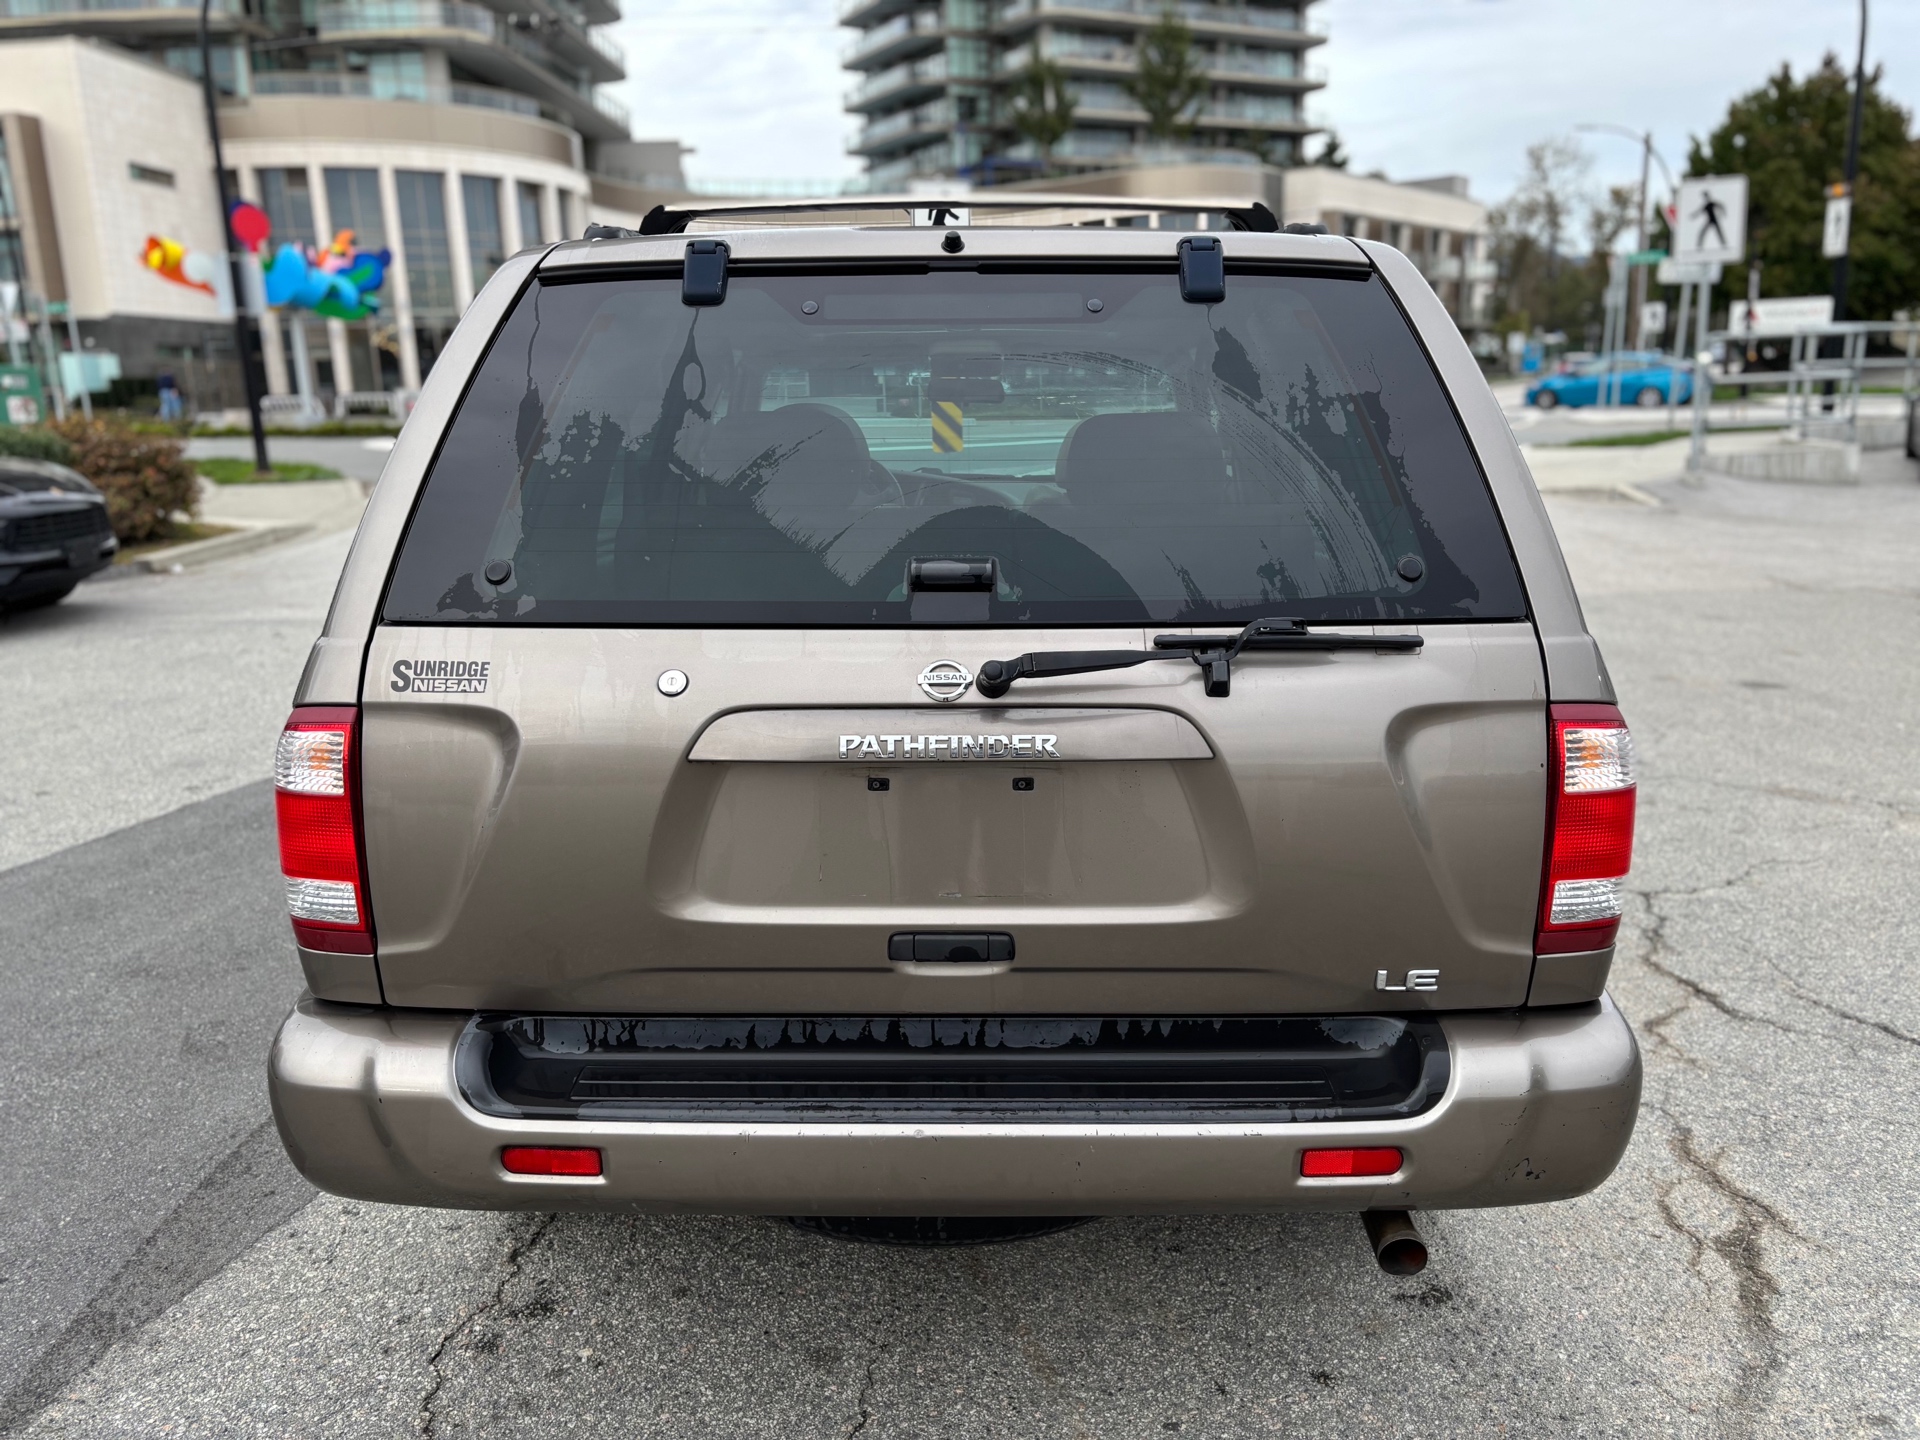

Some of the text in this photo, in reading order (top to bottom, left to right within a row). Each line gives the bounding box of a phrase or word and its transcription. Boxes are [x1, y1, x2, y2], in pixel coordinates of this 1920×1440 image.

[391, 659, 490, 692] SUNRIDGE
[413, 679, 486, 692] NISSAN
[923, 674, 967, 682] NISSAN
[839, 734, 1060, 759] PATHFINDER
[1376, 969, 1440, 991] LE
